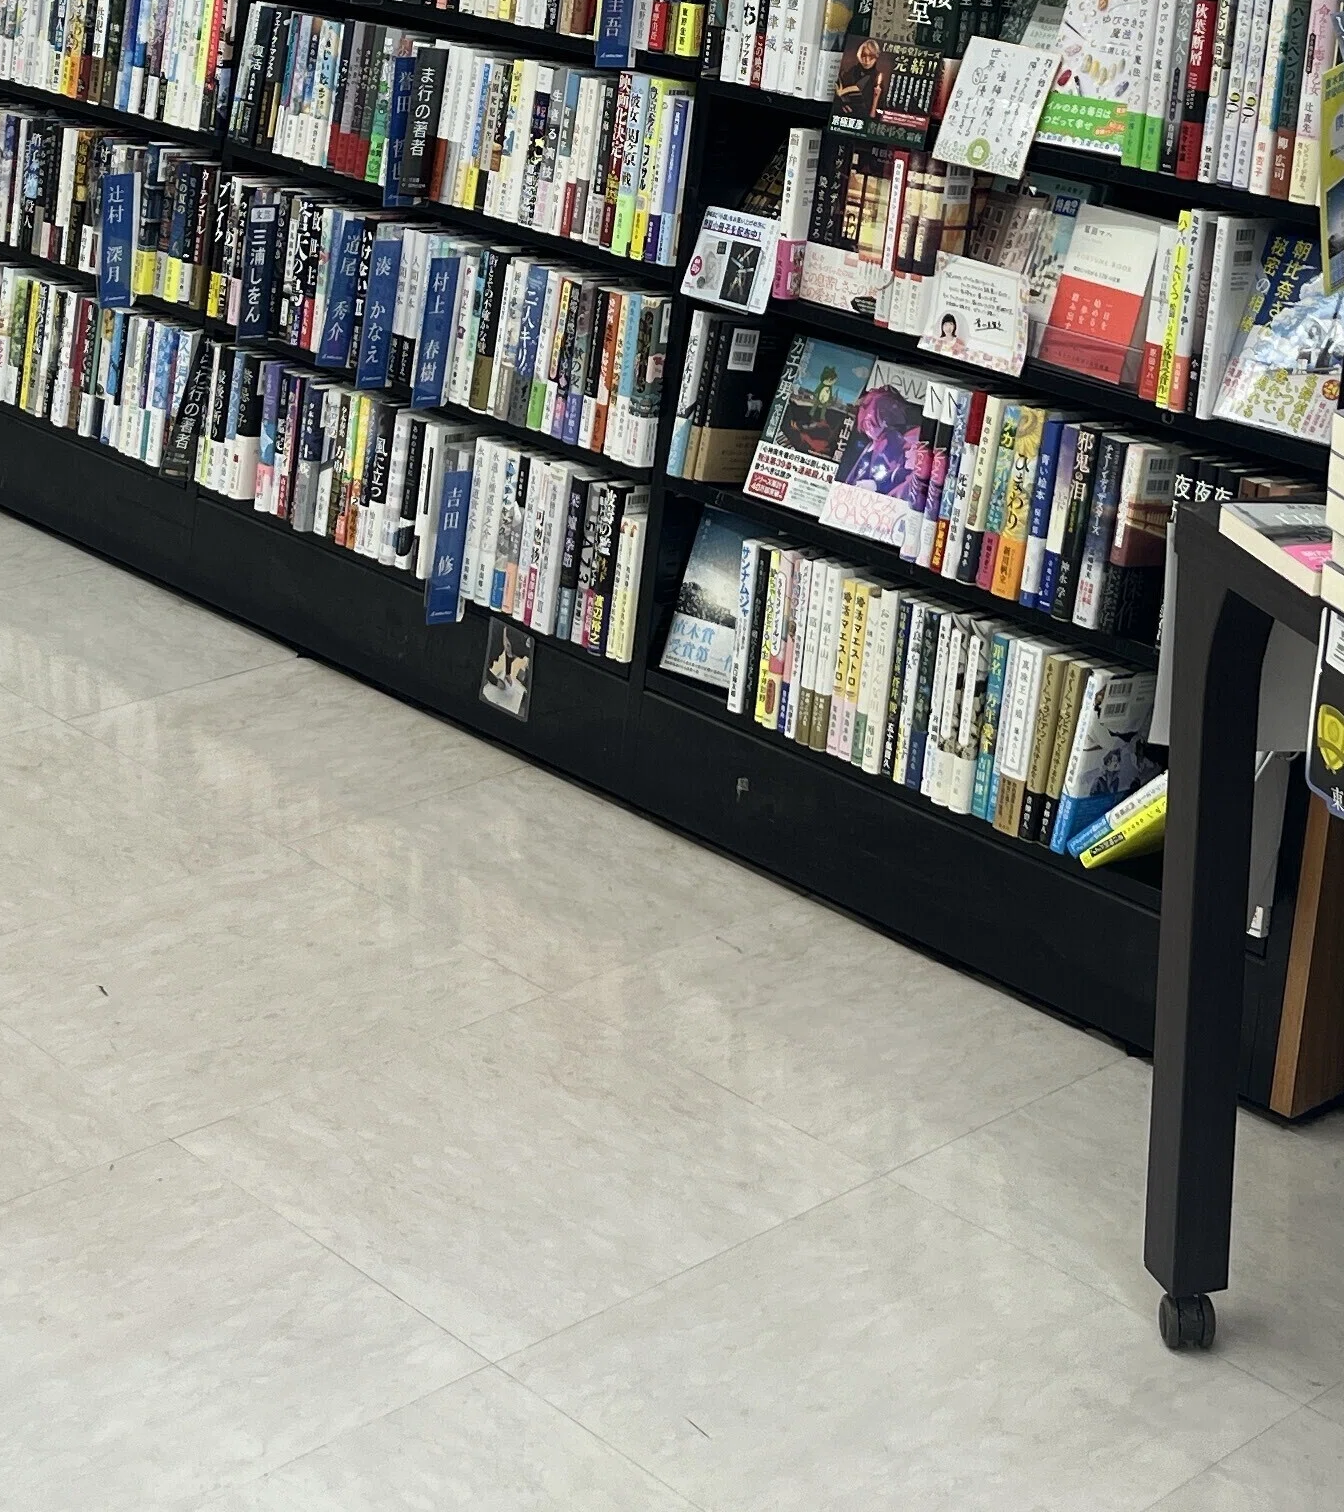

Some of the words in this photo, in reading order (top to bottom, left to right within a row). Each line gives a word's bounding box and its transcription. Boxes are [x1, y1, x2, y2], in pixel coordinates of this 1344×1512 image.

[409, 66, 437, 158] ま行の著者
[830, 114, 864, 130] 京極夏彦
[105, 184, 126, 223] 辻村
[104, 245, 124, 284] 深月
[242, 227, 270, 323] 三浦しをん
[429, 276, 451, 317] 村上
[364, 305, 388, 365] かなえ
[419, 339, 440, 380] 春樹
[442, 484, 464, 531] 吉田
[1006, 451, 1030, 533] ひまわり
[435, 553, 457, 592] 修一
